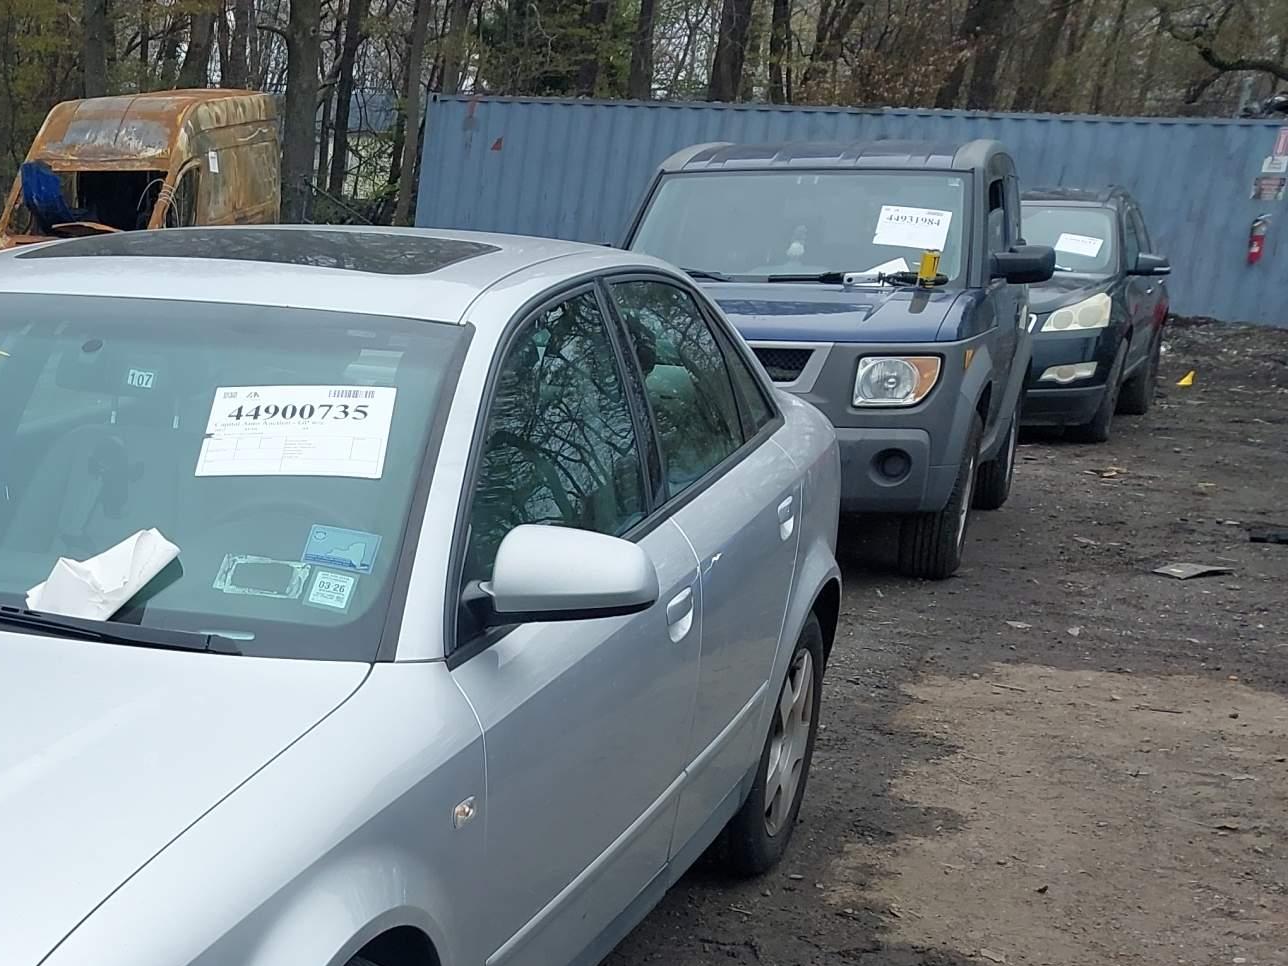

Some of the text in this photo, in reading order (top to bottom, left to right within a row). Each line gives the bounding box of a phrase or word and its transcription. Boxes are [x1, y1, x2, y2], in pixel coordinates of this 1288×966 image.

[885, 213, 942, 227] 44931984
[130, 372, 153, 387] 107
[227, 403, 370, 421] 44900735
